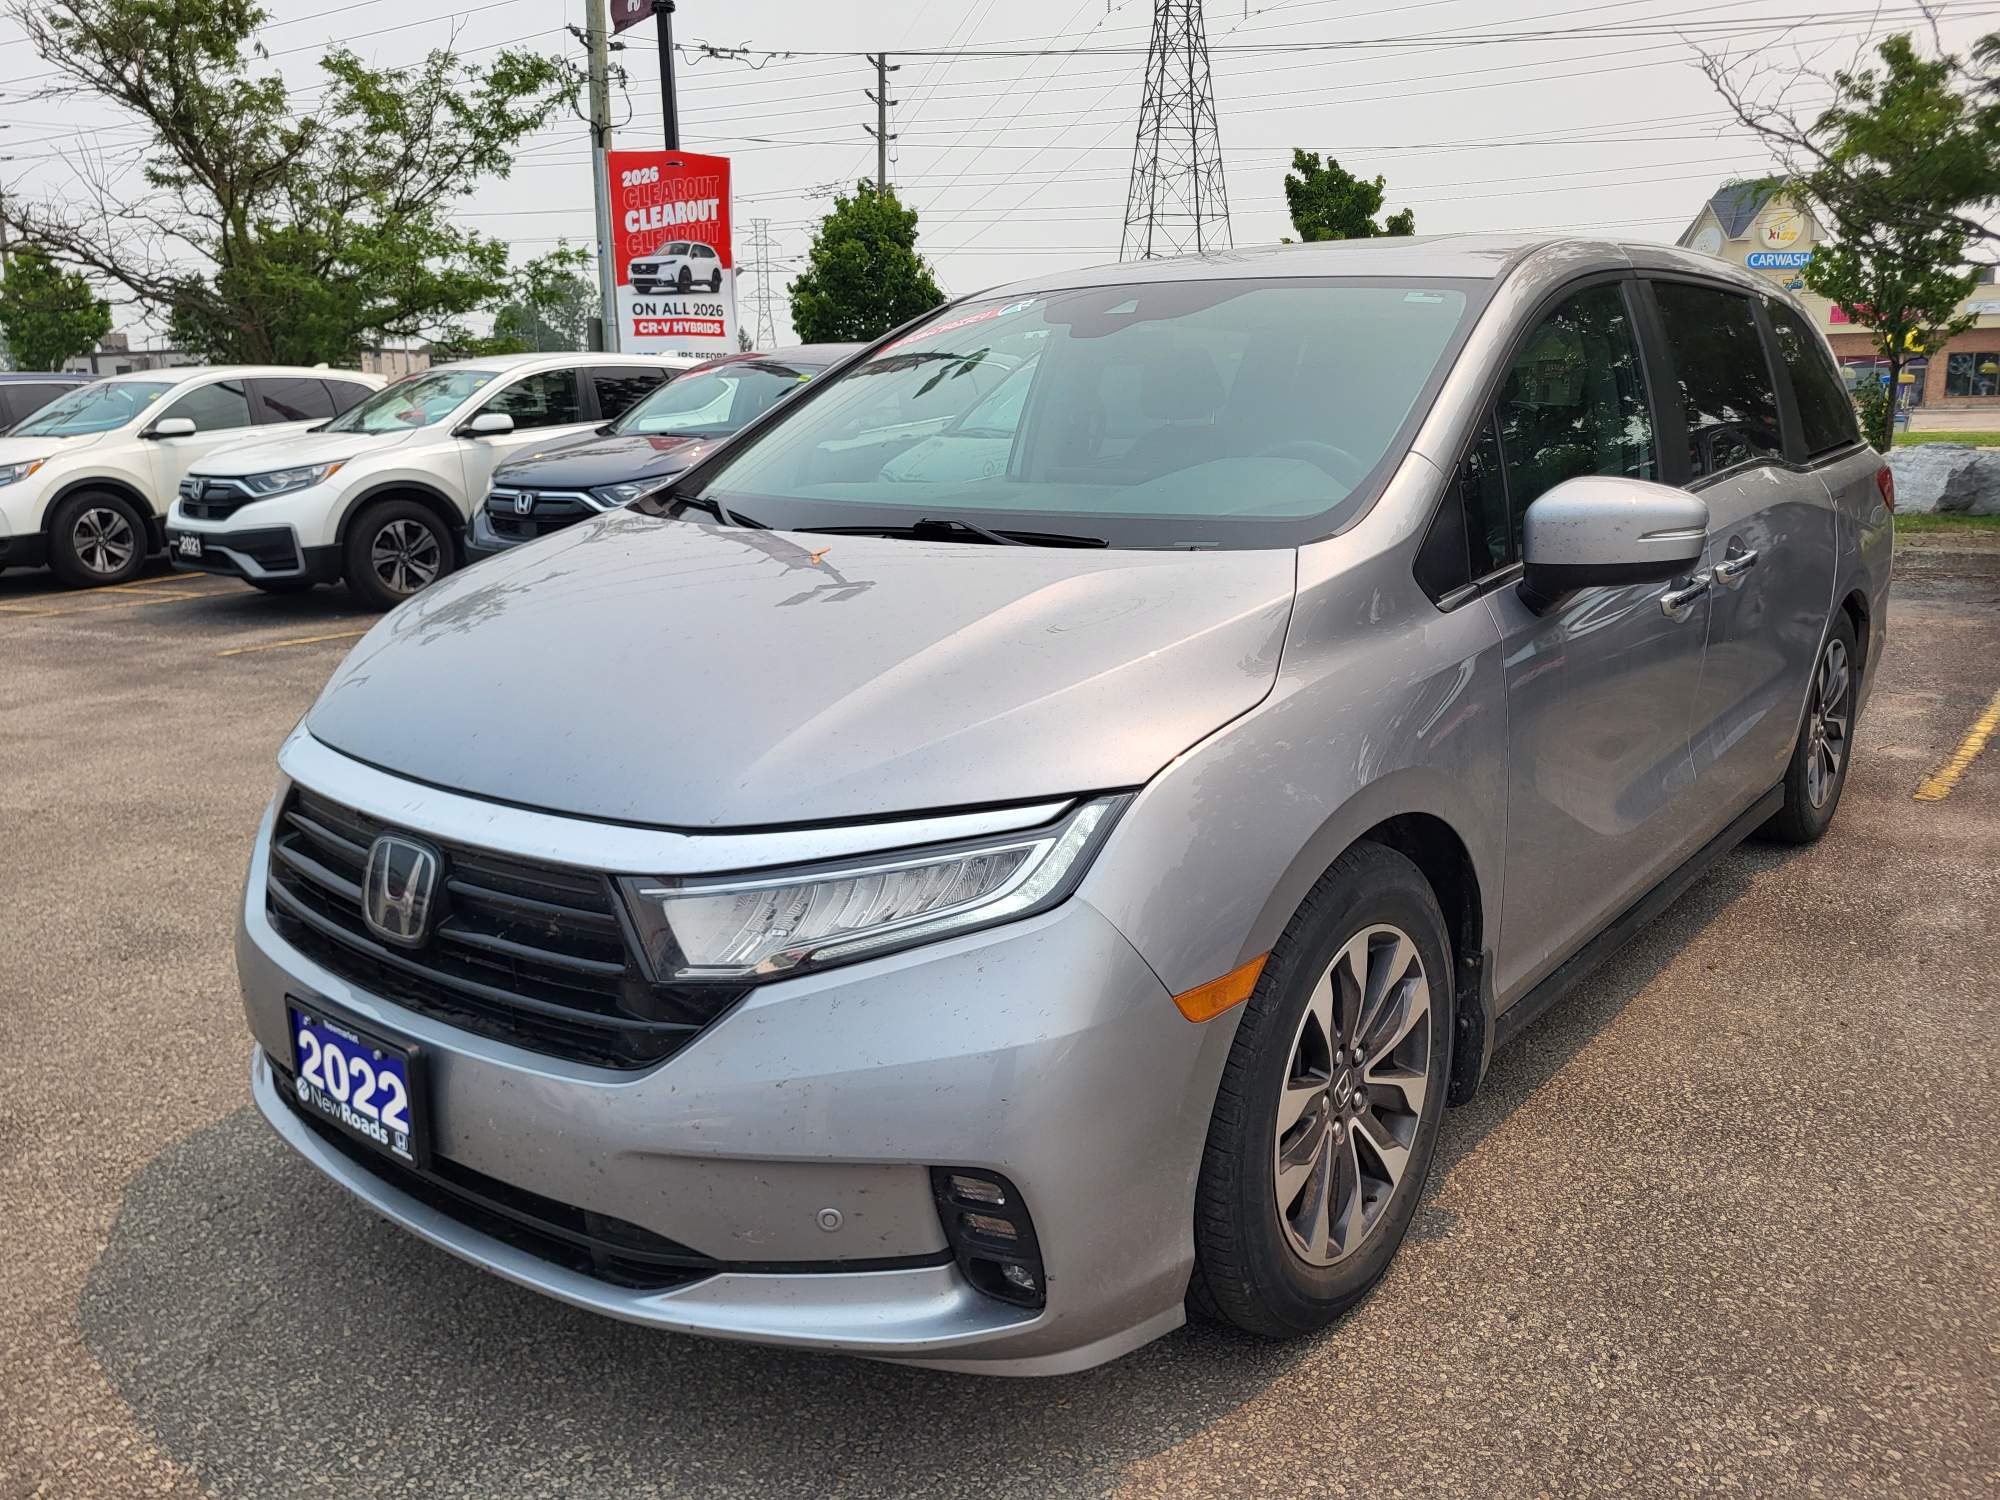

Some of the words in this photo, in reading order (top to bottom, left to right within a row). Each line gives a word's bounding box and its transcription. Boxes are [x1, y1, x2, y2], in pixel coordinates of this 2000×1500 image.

[622, 166, 659, 187] 2026
[623, 176, 719, 210] CLEAROUT
[625, 199, 719, 233] CLEAROUT
[1750, 254, 1810, 266] CARWASH
[632, 303, 656, 316] ON
[663, 302, 690, 315] ALL
[693, 303, 724, 316] 2026
[639, 321, 670, 334] CR-V
[673, 321, 721, 334] HYBRIDS
[298, 1029, 409, 1135] 2022
